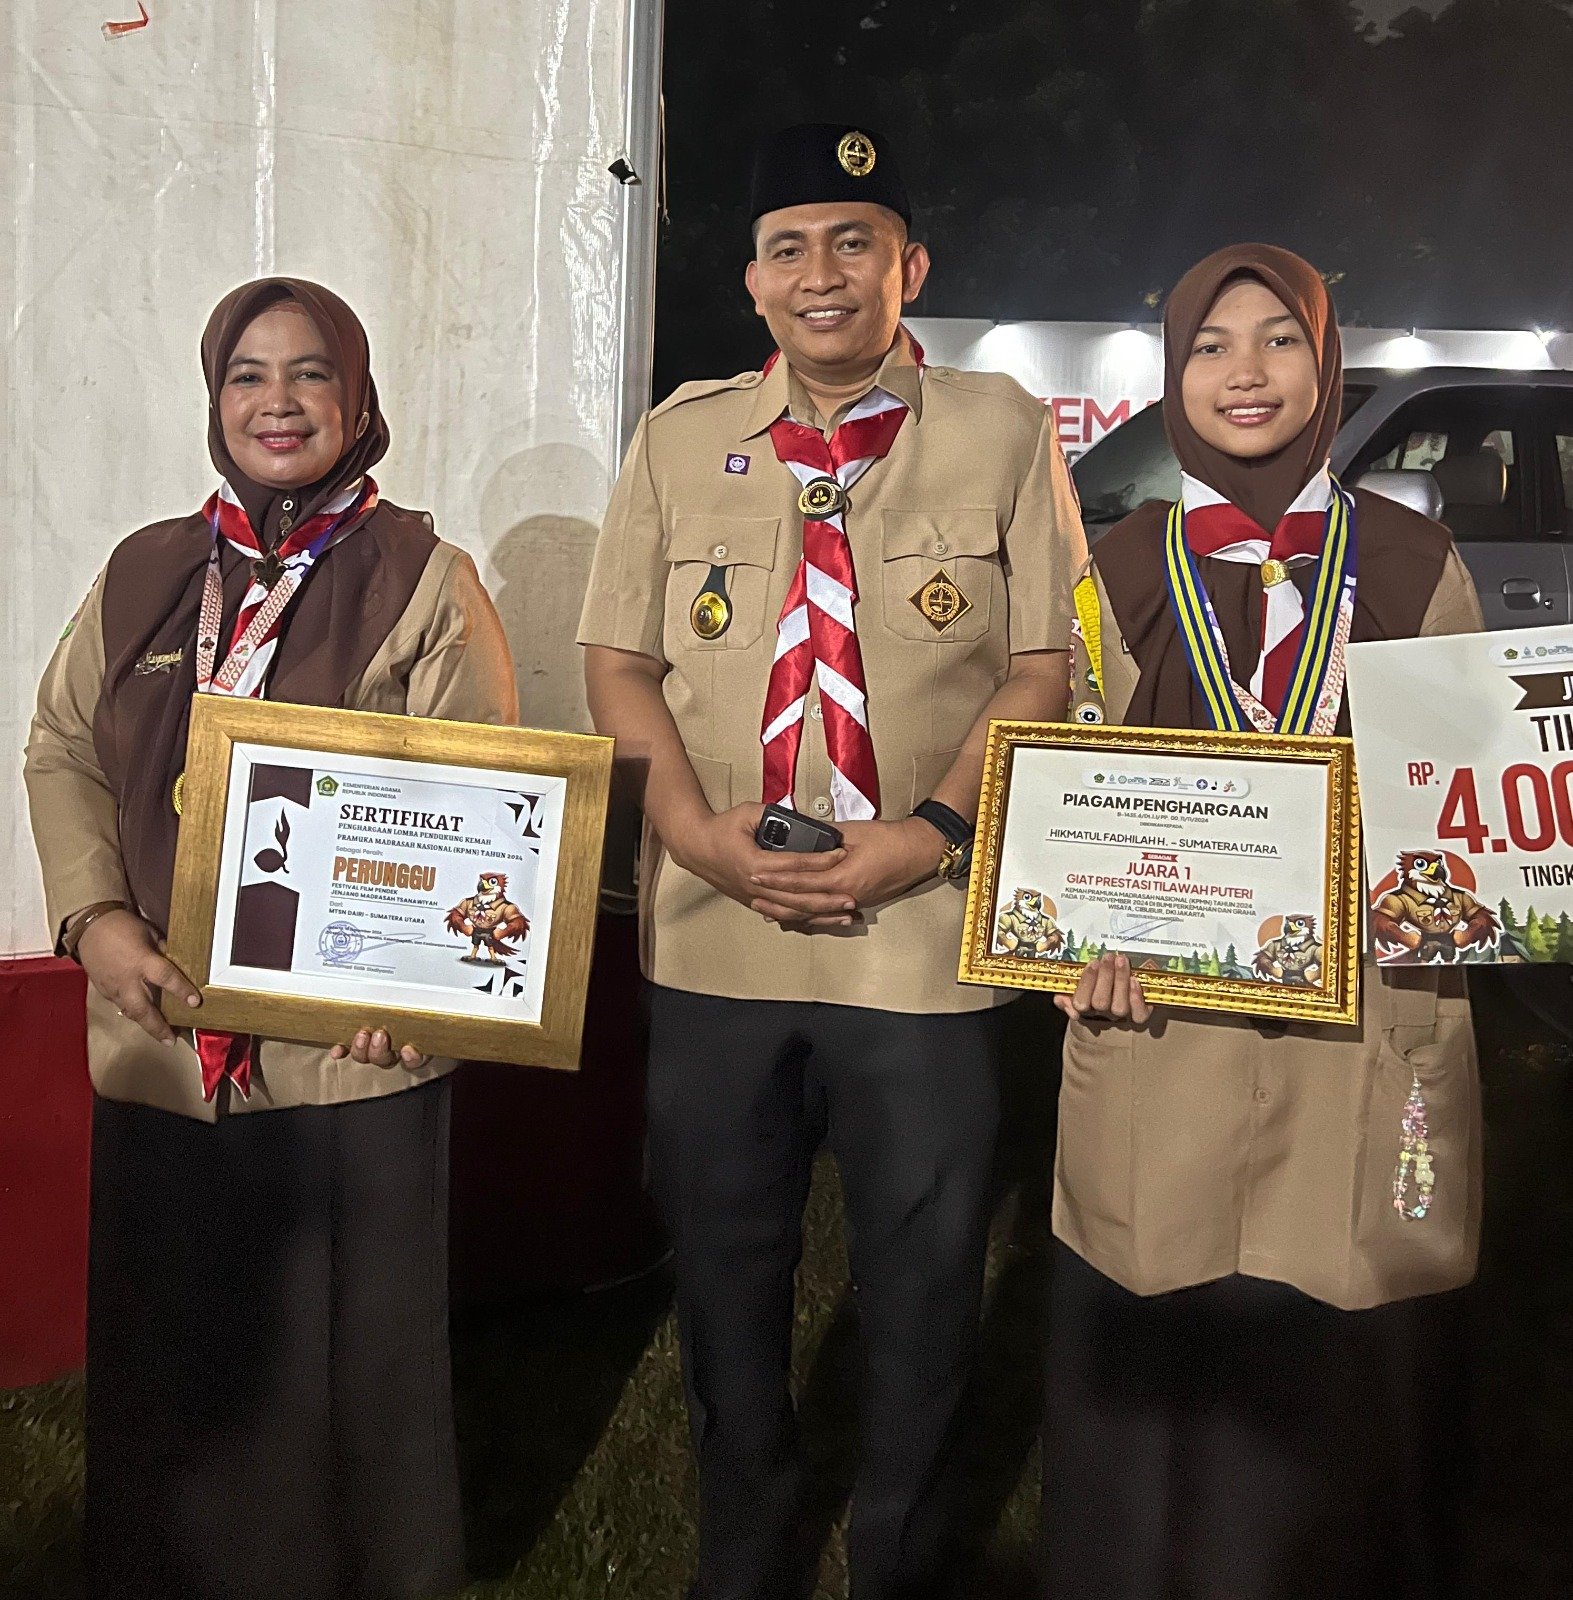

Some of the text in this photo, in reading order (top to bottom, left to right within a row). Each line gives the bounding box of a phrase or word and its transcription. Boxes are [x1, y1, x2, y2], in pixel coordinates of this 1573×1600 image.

[1408, 762, 1440, 786] RP.
[1063, 793, 1268, 820] PIAGAM PENGHARGAAN
[340, 804, 463, 832] SERTIFIKAT
[338, 823, 491, 845] PENGHARGAAN LOMBA PENDUKUNG KEMAH
[1050, 828, 1102, 841] HIKMATUL
[1103, 833, 1156, 845] FADHILAH
[1157, 837, 1168, 846] H.
[1179, 838, 1239, 852] SUMATERA
[1240, 843, 1278, 854] UTARA
[336, 846, 361, 854] Sebagai
[337, 834, 373, 843] PRAMUKA
[375, 839, 415, 848] MADRASAH
[417, 842, 452, 852] NASIONAL
[453, 847, 479, 856] (KPMN)
[481, 850, 506, 858] TAHUN
[333, 856, 436, 891] PERUNGGU
[1126, 862, 1191, 880] JUARA 1
[1066, 873, 1253, 899] GIAT PRESTASI TILAWAH PUTERI
[360, 893, 396, 902] MADRASAH
[397, 897, 438, 906] TSANAWIYAH
[1088, 889, 1118, 897] PRAMUKA
[1119, 891, 1155, 900] MADRASAH
[1156, 895, 1187, 903] NASIONAL
[1189, 898, 1212, 906] (KPMN)
[1097, 896, 1131, 904] NOVEMBER
[1173, 903, 1217, 912] PERKEMAHAN
[370, 913, 403, 921] SUMATERA
[1177, 910, 1205, 918] JAKARTA
